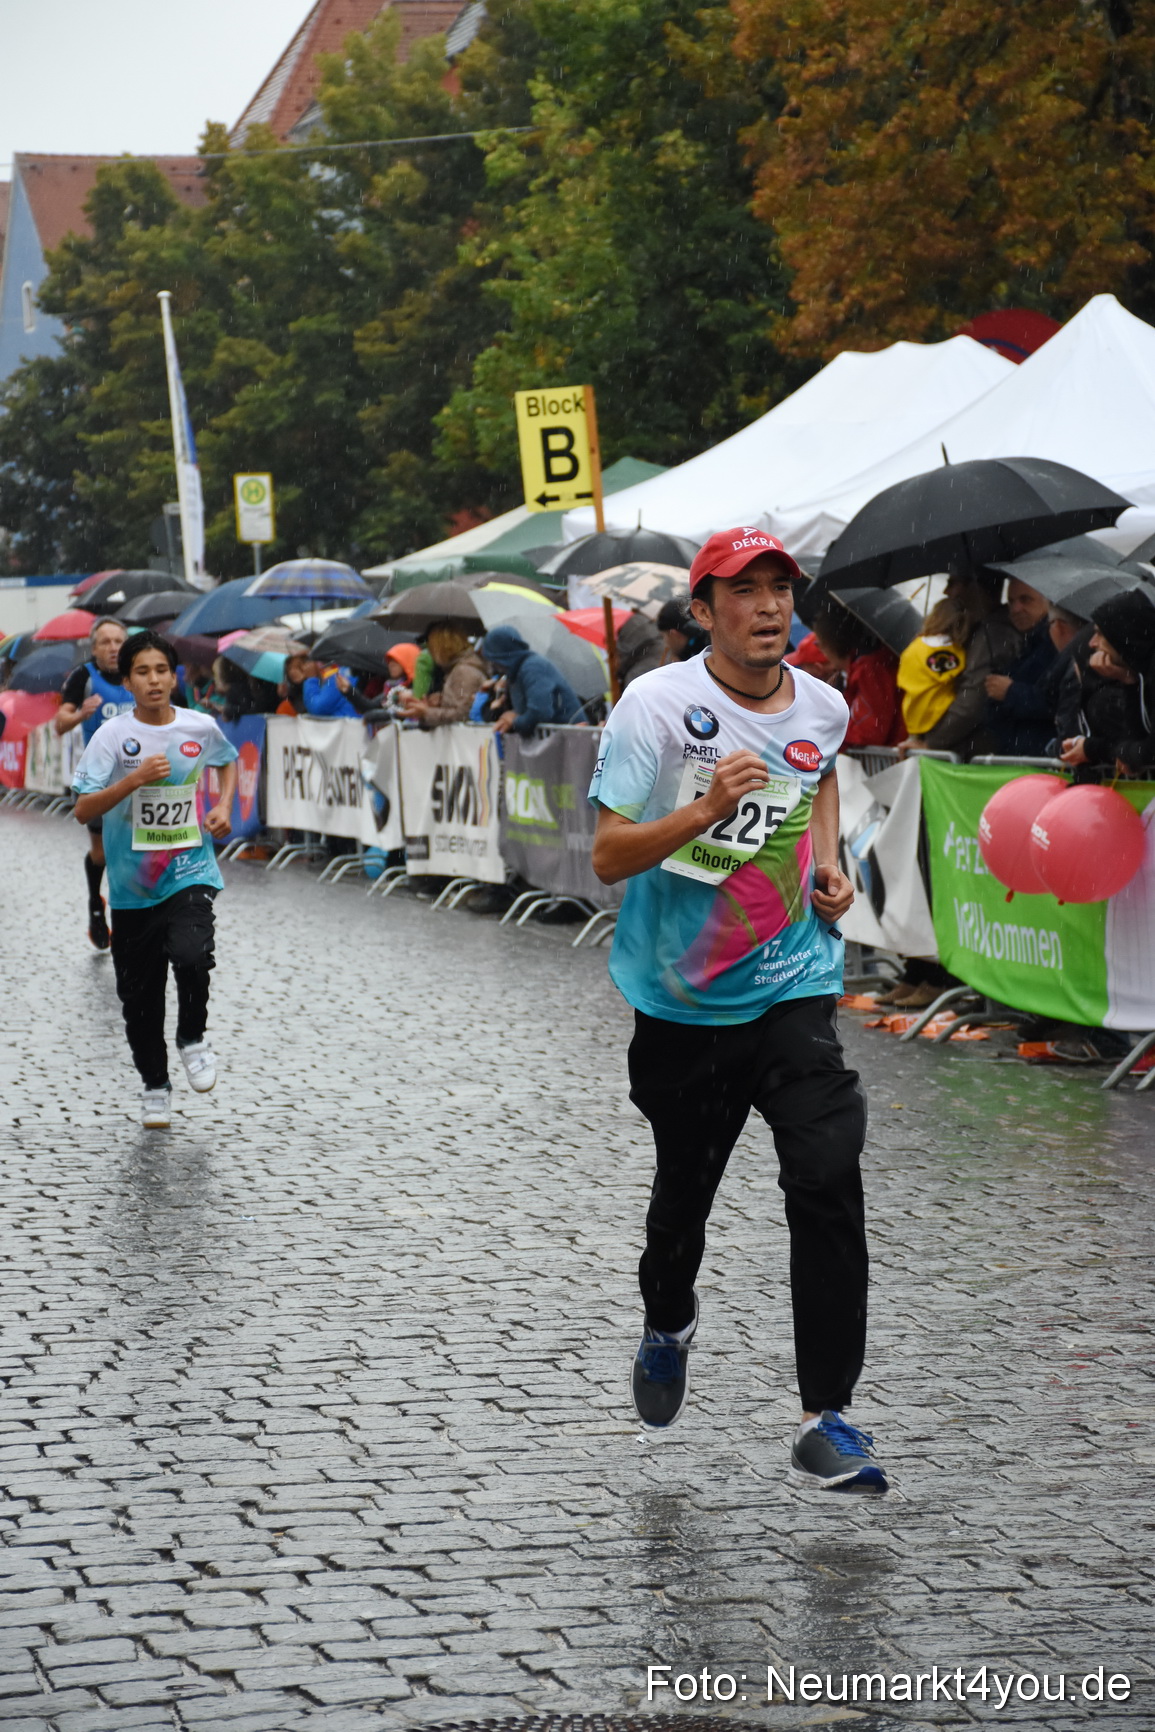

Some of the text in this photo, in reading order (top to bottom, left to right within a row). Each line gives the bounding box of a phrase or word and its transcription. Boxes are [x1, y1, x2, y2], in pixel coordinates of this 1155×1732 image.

[526, 392, 585, 417] Block
[540, 426, 579, 483] B
[732, 536, 778, 551] DEKRA
[682, 753, 718, 765] Neumark
[684, 743, 721, 758] PARTL
[141, 800, 192, 826] 5227
[694, 790, 787, 846] 225
[146, 830, 188, 842] Mohanad
[691, 845, 753, 873] Choda
[954, 897, 1063, 970] Willkommen
[763, 940, 783, 959] 17.
